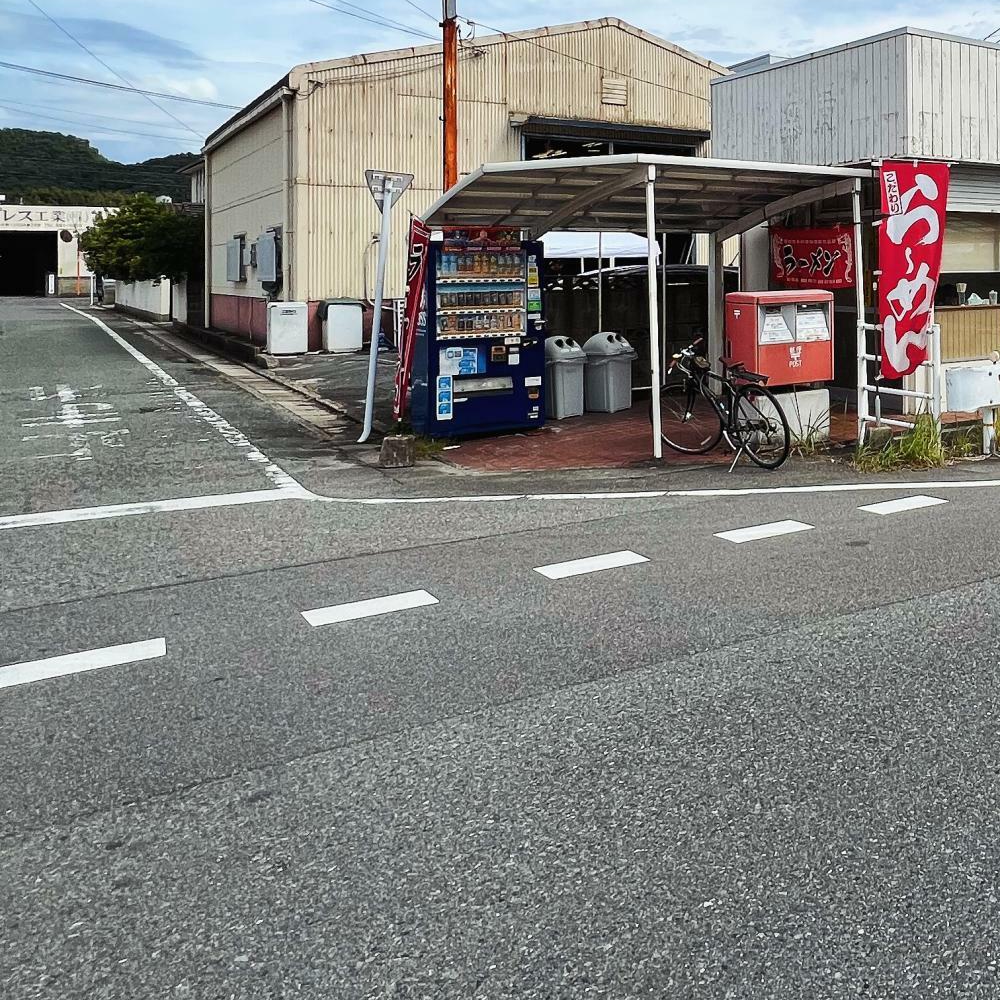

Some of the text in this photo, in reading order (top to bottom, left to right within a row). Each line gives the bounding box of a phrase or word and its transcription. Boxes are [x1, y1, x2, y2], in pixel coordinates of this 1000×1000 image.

[886, 173, 900, 213] こだわり
[783, 244, 841, 277] ラーメン
[789, 360, 802, 368] POST
